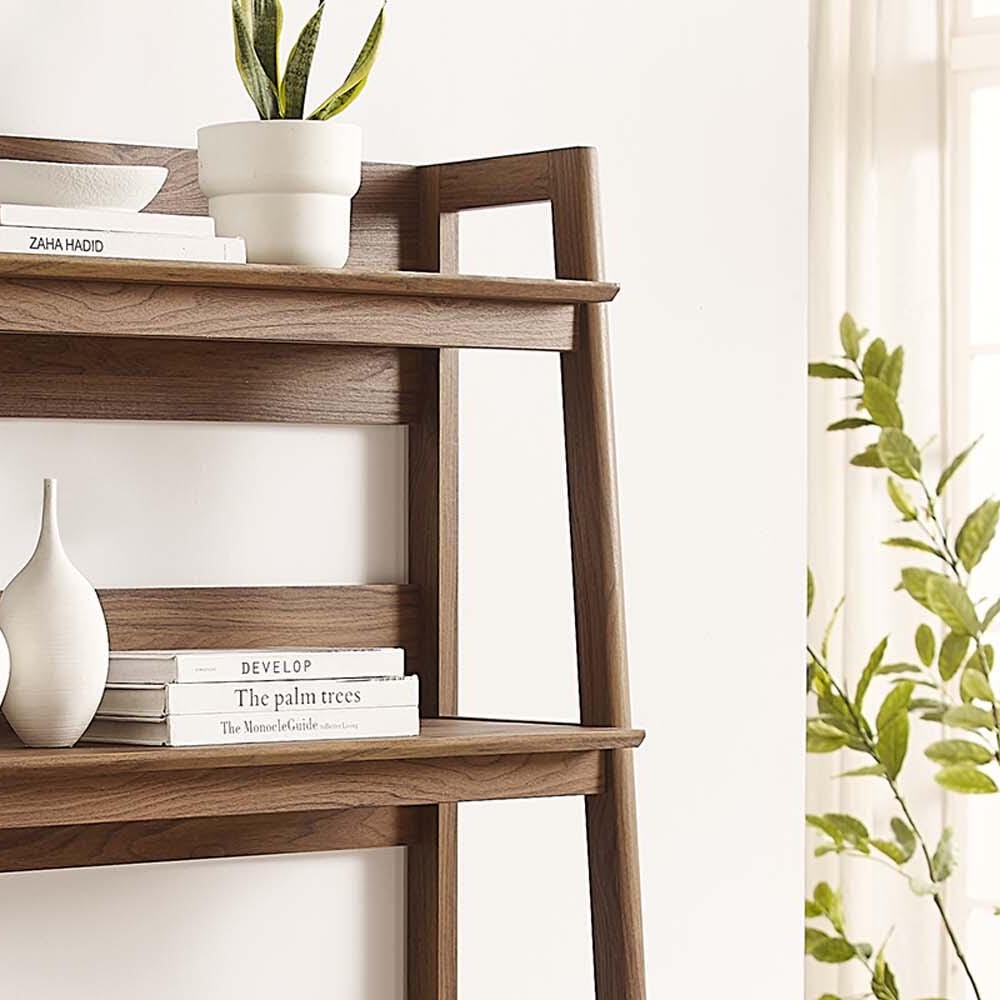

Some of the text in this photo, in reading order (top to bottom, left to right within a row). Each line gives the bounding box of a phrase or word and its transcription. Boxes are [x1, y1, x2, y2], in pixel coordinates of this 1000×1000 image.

[29, 236, 104, 253] ZAHA HADID
[241, 659, 313, 675] DEVELOP
[234, 686, 362, 711] The palm trees
[220, 720, 241, 735] The
